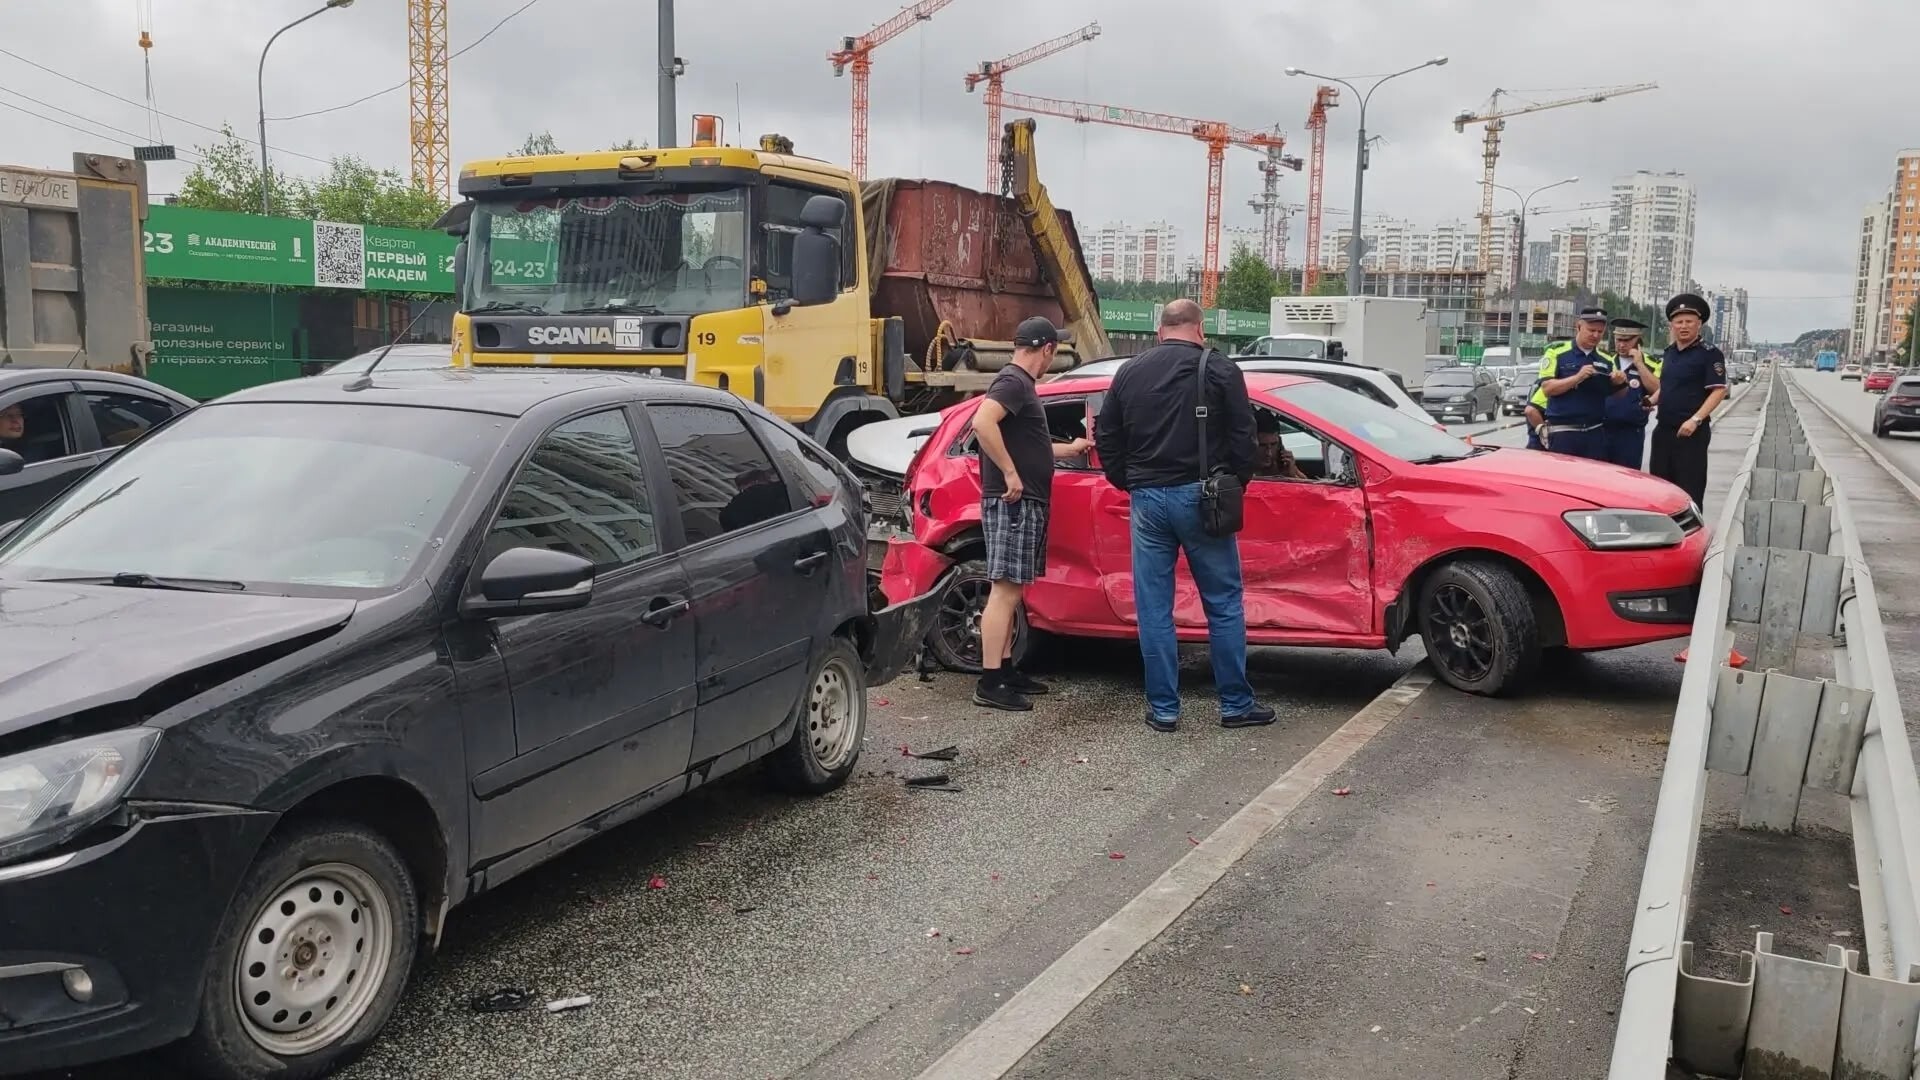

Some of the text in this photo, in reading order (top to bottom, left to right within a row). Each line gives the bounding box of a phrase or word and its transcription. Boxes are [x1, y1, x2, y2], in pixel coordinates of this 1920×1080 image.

[14, 179, 70, 200] FUTURE
[205, 236, 277, 251] АКАДЕМИЧЕСКИЙ
[365, 234, 416, 250] Квартал
[366, 251, 428, 266] ПЕРВЫЙ
[366, 267, 428, 282] АКАДЕМ
[150, 322, 214, 333] агазины
[528, 326, 615, 345] SCANIA
[696, 332, 716, 346] 19
[153, 339, 224, 349] полезные
[161, 355, 216, 366] первых
[218, 355, 269, 365] этажах
[858, 361, 867, 373] 19
